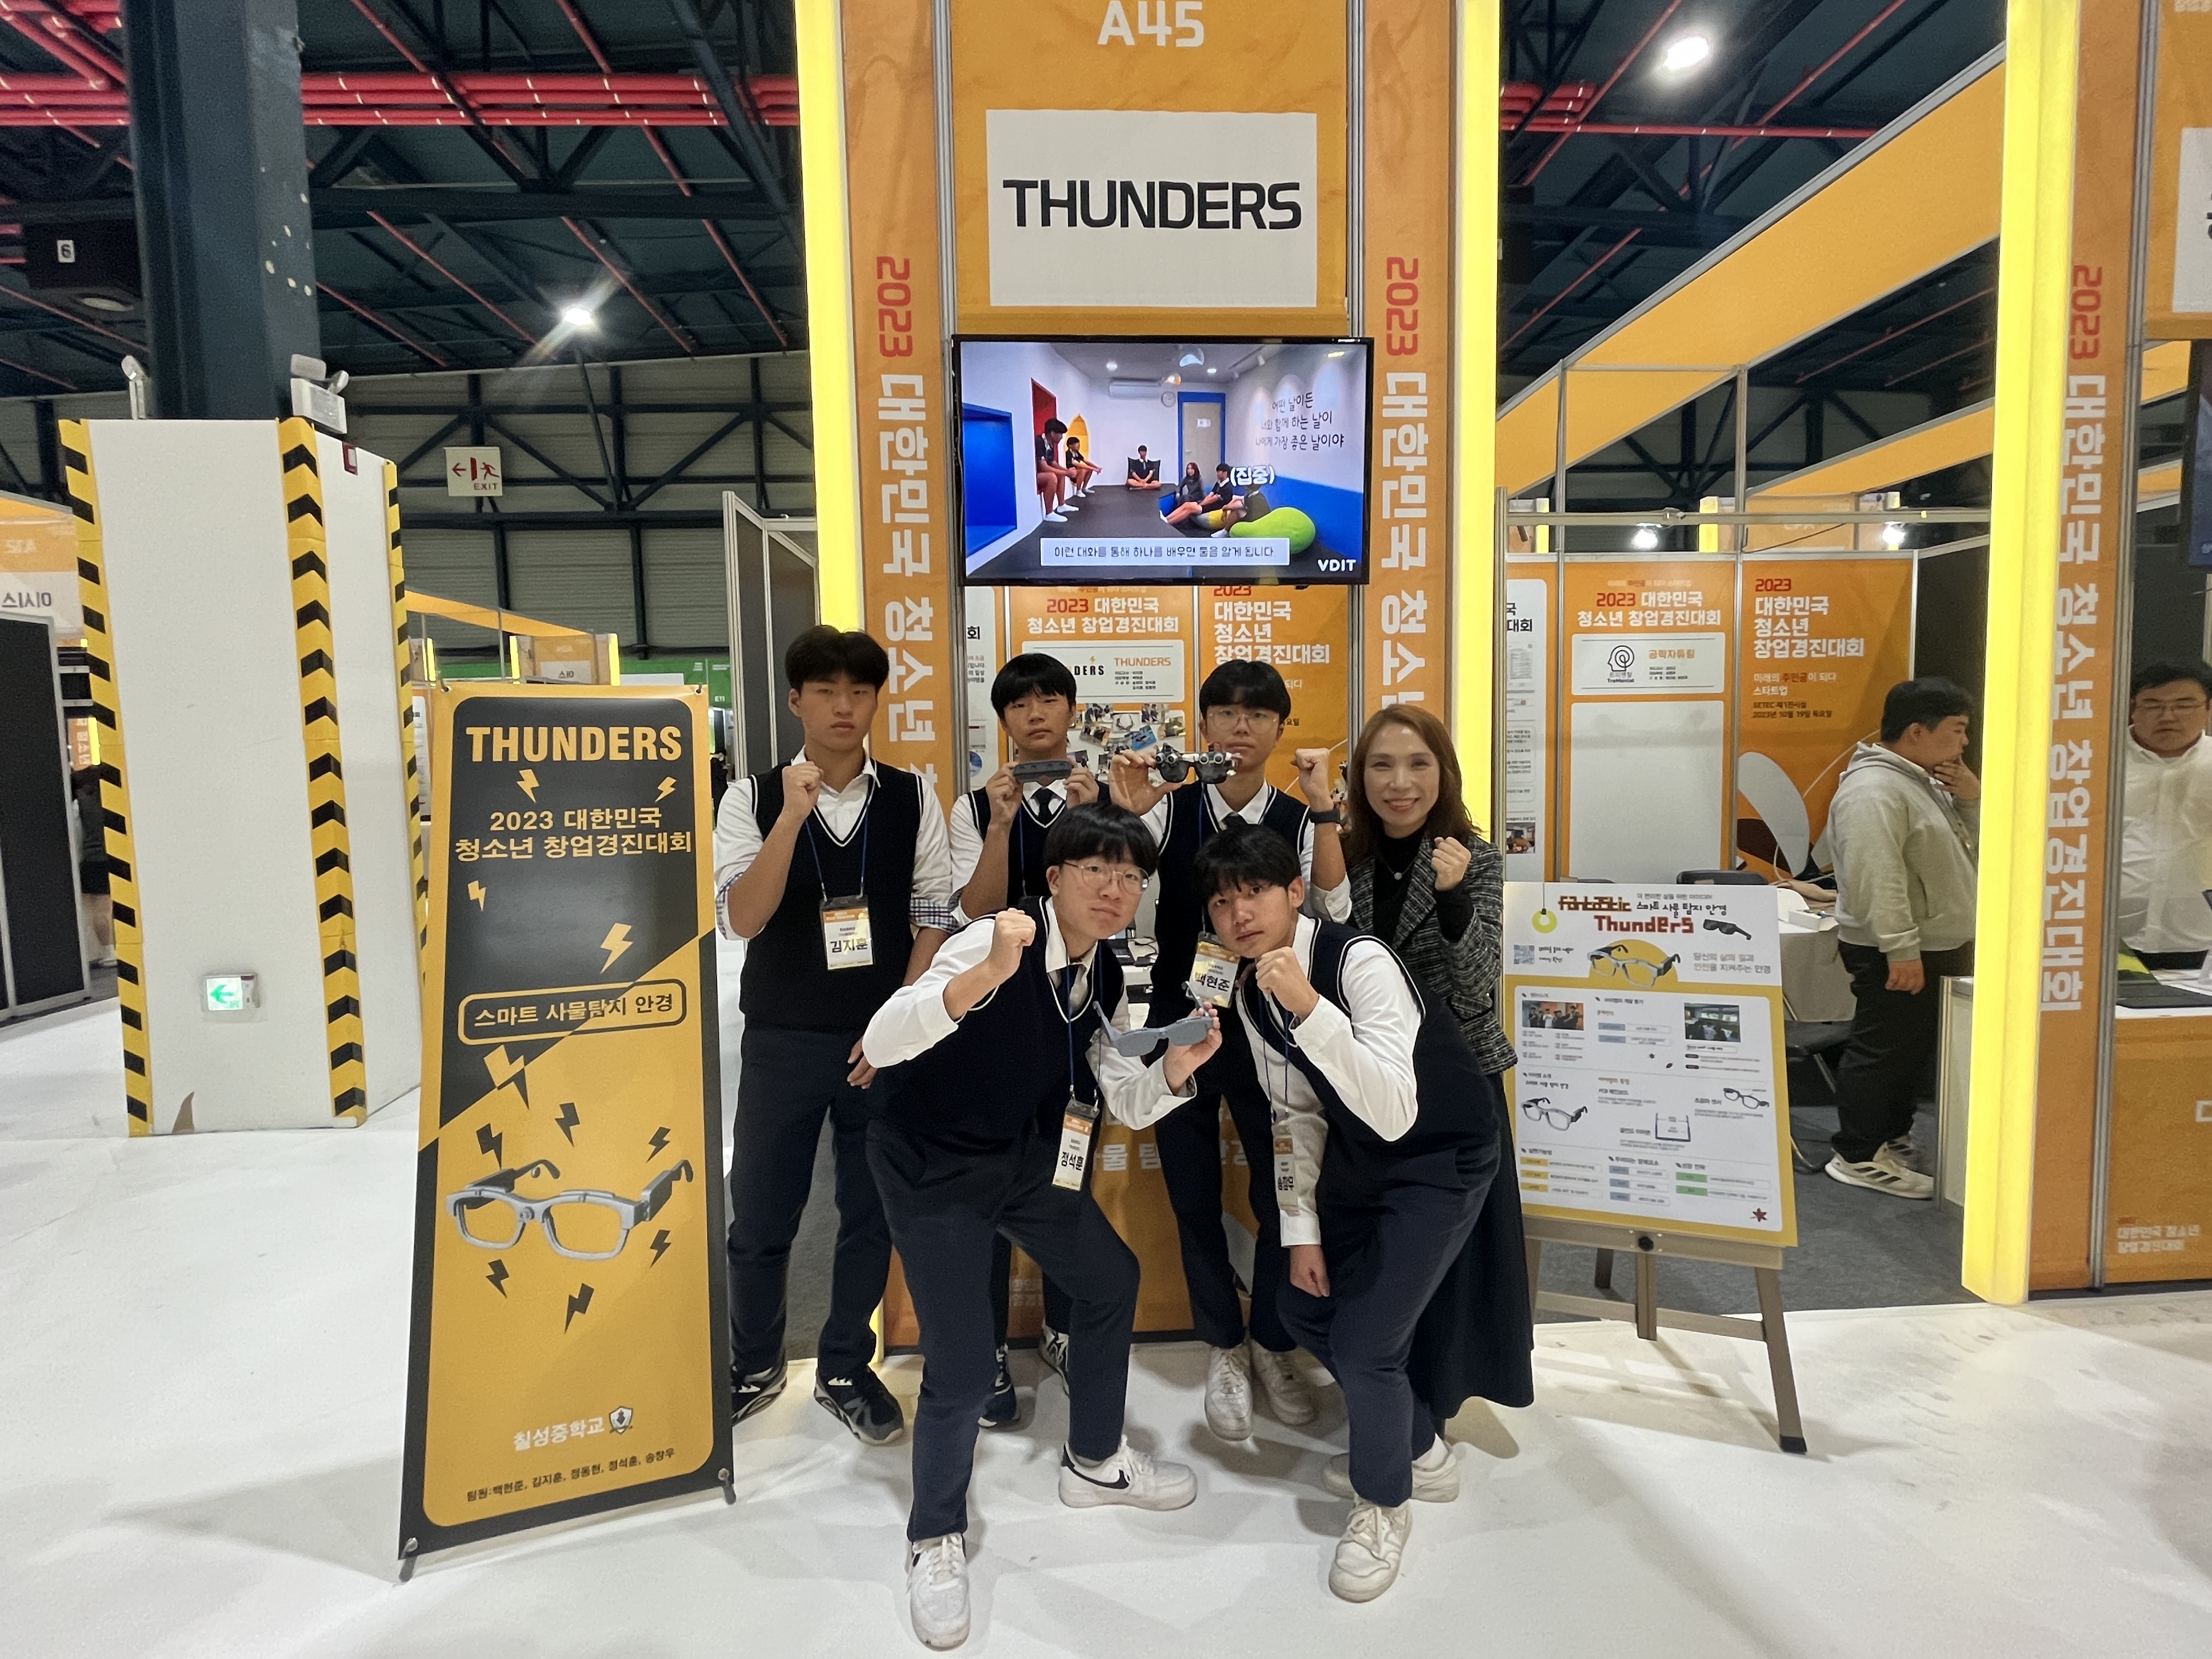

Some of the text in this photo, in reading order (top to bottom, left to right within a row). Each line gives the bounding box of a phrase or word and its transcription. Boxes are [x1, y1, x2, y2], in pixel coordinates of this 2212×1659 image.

[1097, 0, 1205, 47] A45
[1003, 179, 1302, 230] THUNDERS
[60, 244, 71, 258] 6
[877, 256, 913, 358] 2023
[1386, 257, 1419, 356] 2023
[1291, 415, 1308, 430] 하는
[1312, 410, 1332, 430] 날이
[1311, 433, 1344, 451] 날이야
[878, 374, 931, 577] 대한민국
[1381, 372, 1429, 571] 대한민국
[1318, 558, 1357, 572] VDIT
[1755, 578, 1792, 592] 2023
[1046, 597, 1160, 613] 2023 대한민국
[1596, 591, 1703, 607] 2023 대한민국
[1755, 596, 1830, 616] 대한민국
[1214, 601, 1292, 621] 대한민국
[1577, 610, 1721, 627] 청소년 창업경진대회
[1027, 616, 1179, 634] 청소년 창업경진대회
[1214, 623, 1272, 643] 청소년
[1754, 618, 1809, 637] 청소년
[2041, 264, 2106, 1011] 2023 대한민국 청소년 창업경진대회
[1753, 637, 1865, 659] 창업경진대회
[885, 596, 936, 742] 청소년
[1068, 665, 1104, 676] DERS
[1114, 657, 1171, 667] THUNDERS
[466, 725, 682, 763] THUNDERS
[490, 807, 662, 831] 2023 대한민국
[455, 831, 692, 862] 청소년 창업경진대회
[830, 938, 868, 953] 김지훈
[474, 994, 673, 1027] 스마트 사물탐지 안경
[513, 1417, 605, 1452] 칠성중학교
